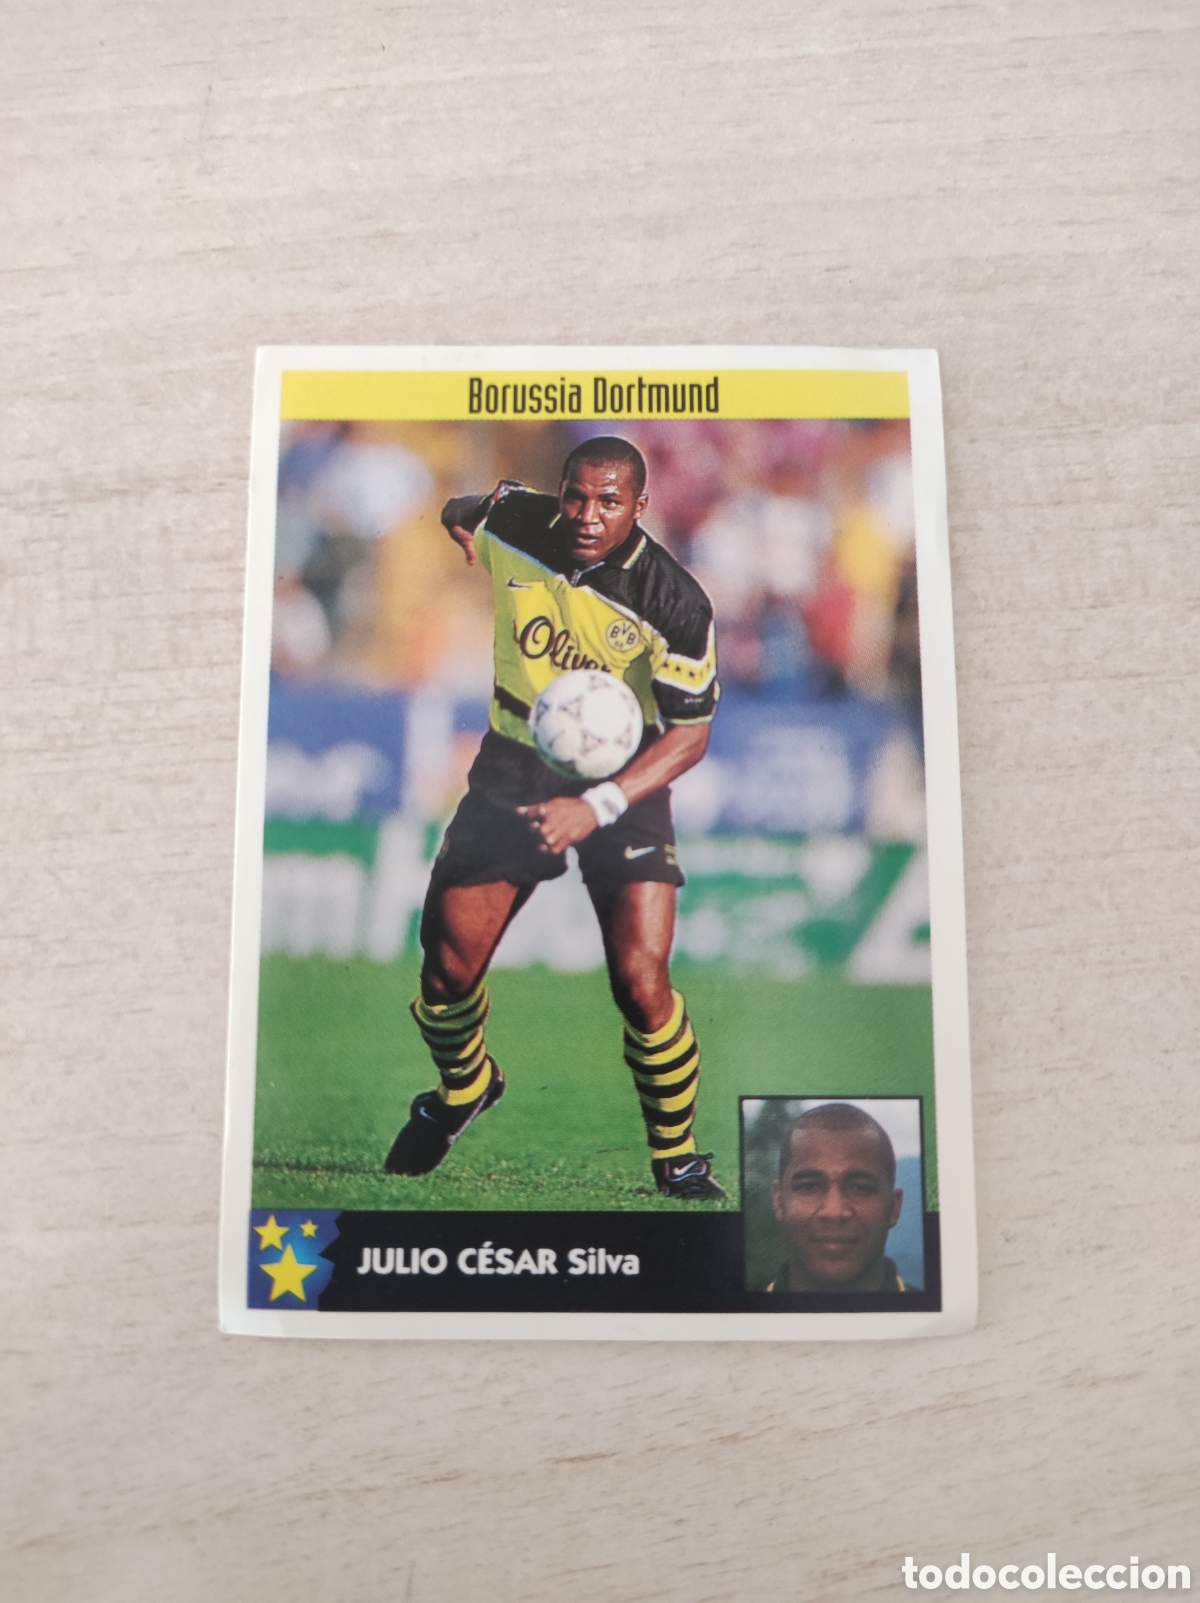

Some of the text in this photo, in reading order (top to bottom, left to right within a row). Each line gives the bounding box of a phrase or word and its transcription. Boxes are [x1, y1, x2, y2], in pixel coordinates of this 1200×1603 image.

[468, 376, 720, 414] Borussia Dortmund
[610, 621, 636, 645] BVB
[356, 1240, 640, 1275] JULIO CÉSAR Silva
